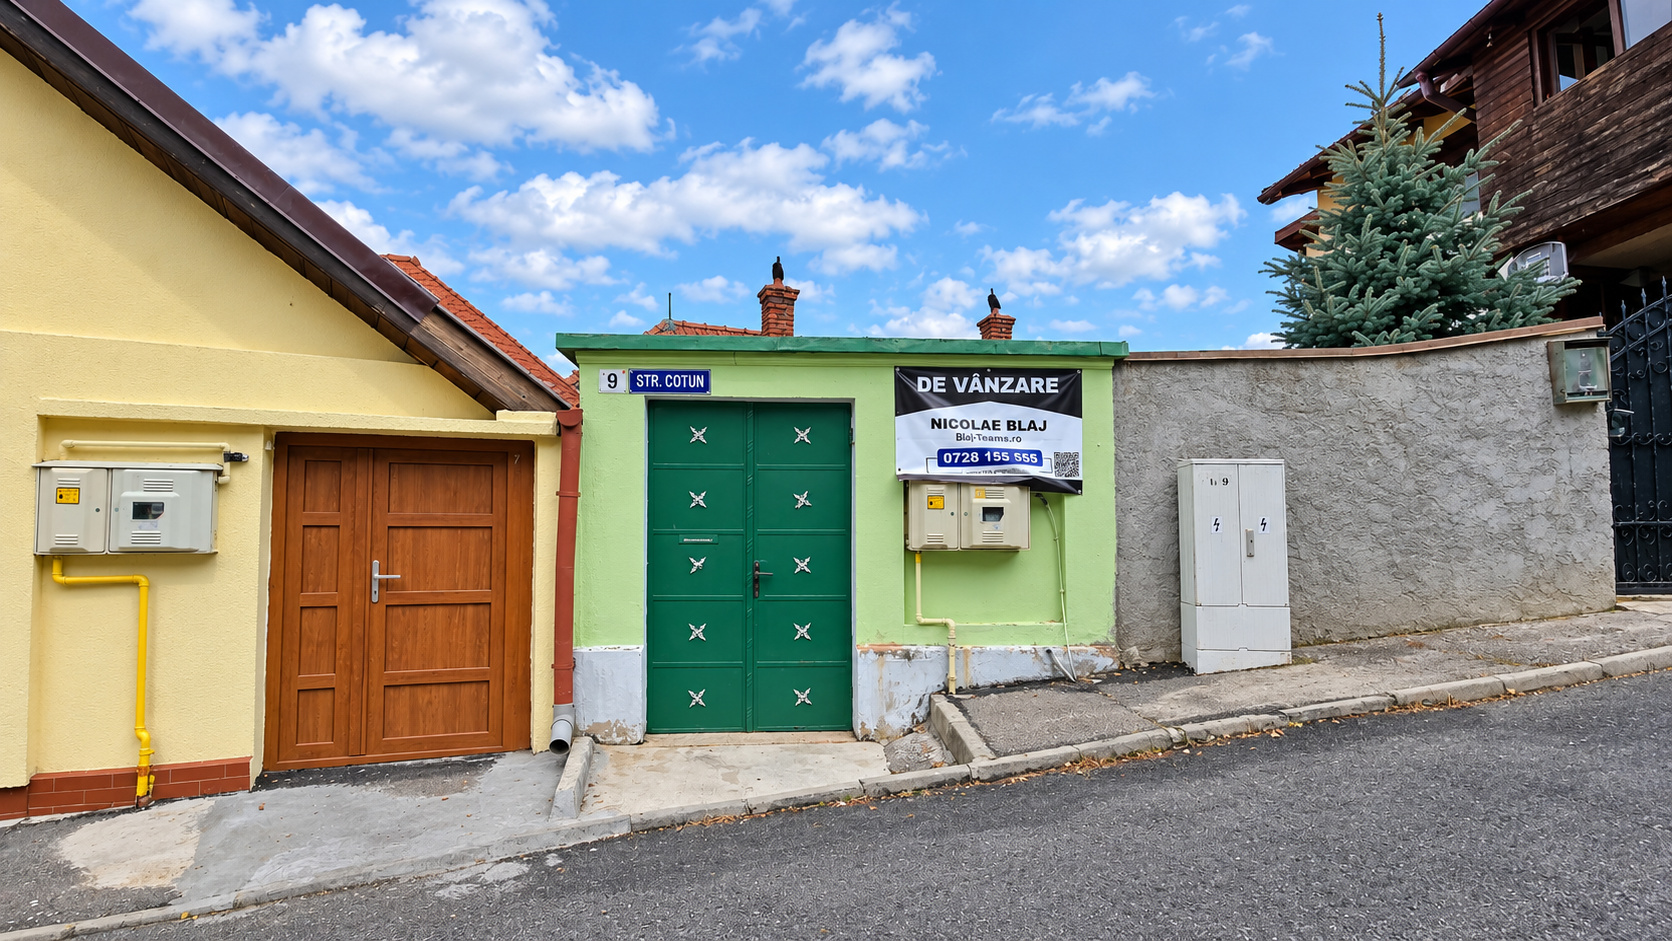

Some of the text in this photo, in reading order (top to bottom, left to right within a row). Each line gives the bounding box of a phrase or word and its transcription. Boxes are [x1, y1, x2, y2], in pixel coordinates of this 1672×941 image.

[607, 373, 618, 389] 9
[636, 374, 704, 388] STR. COTUN
[917, 373, 1059, 394] DE VÂNZARE
[930, 418, 1047, 432] NICOLAE BLAJ
[943, 452, 980, 463] 0728
[984, 451, 1010, 462] 155
[1222, 477, 1229, 486] 9
